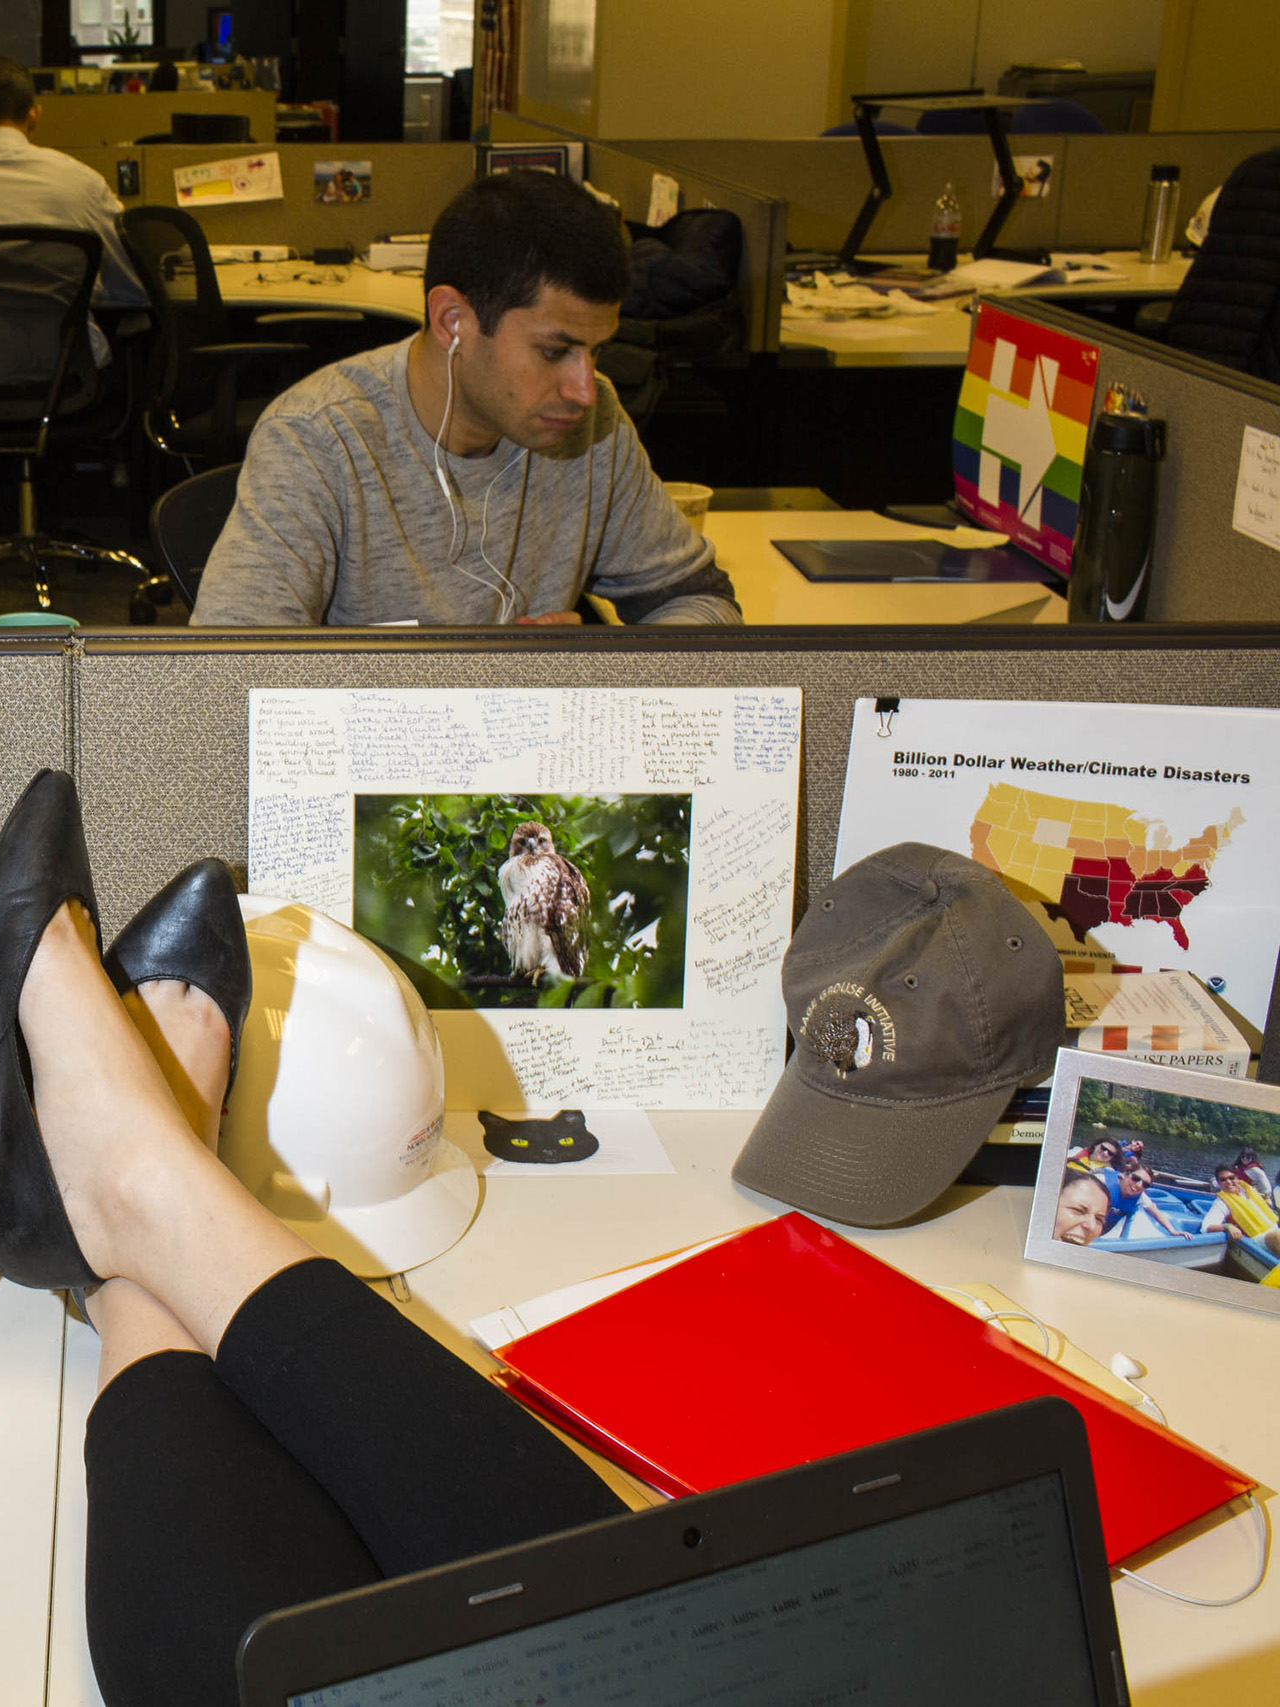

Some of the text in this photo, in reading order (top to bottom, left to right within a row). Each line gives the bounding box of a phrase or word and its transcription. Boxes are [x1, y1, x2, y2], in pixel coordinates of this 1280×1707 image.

[891, 768, 919, 778] 1980
[928, 769, 956, 779] 2011
[893, 751, 1251, 785] Billion Dollar Weather/Climate Disasters
[819, 982, 866, 1002] GROUSE
[863, 993, 897, 1063] INITIATIVE
[1169, 1054, 1224, 1066] PAPERS
